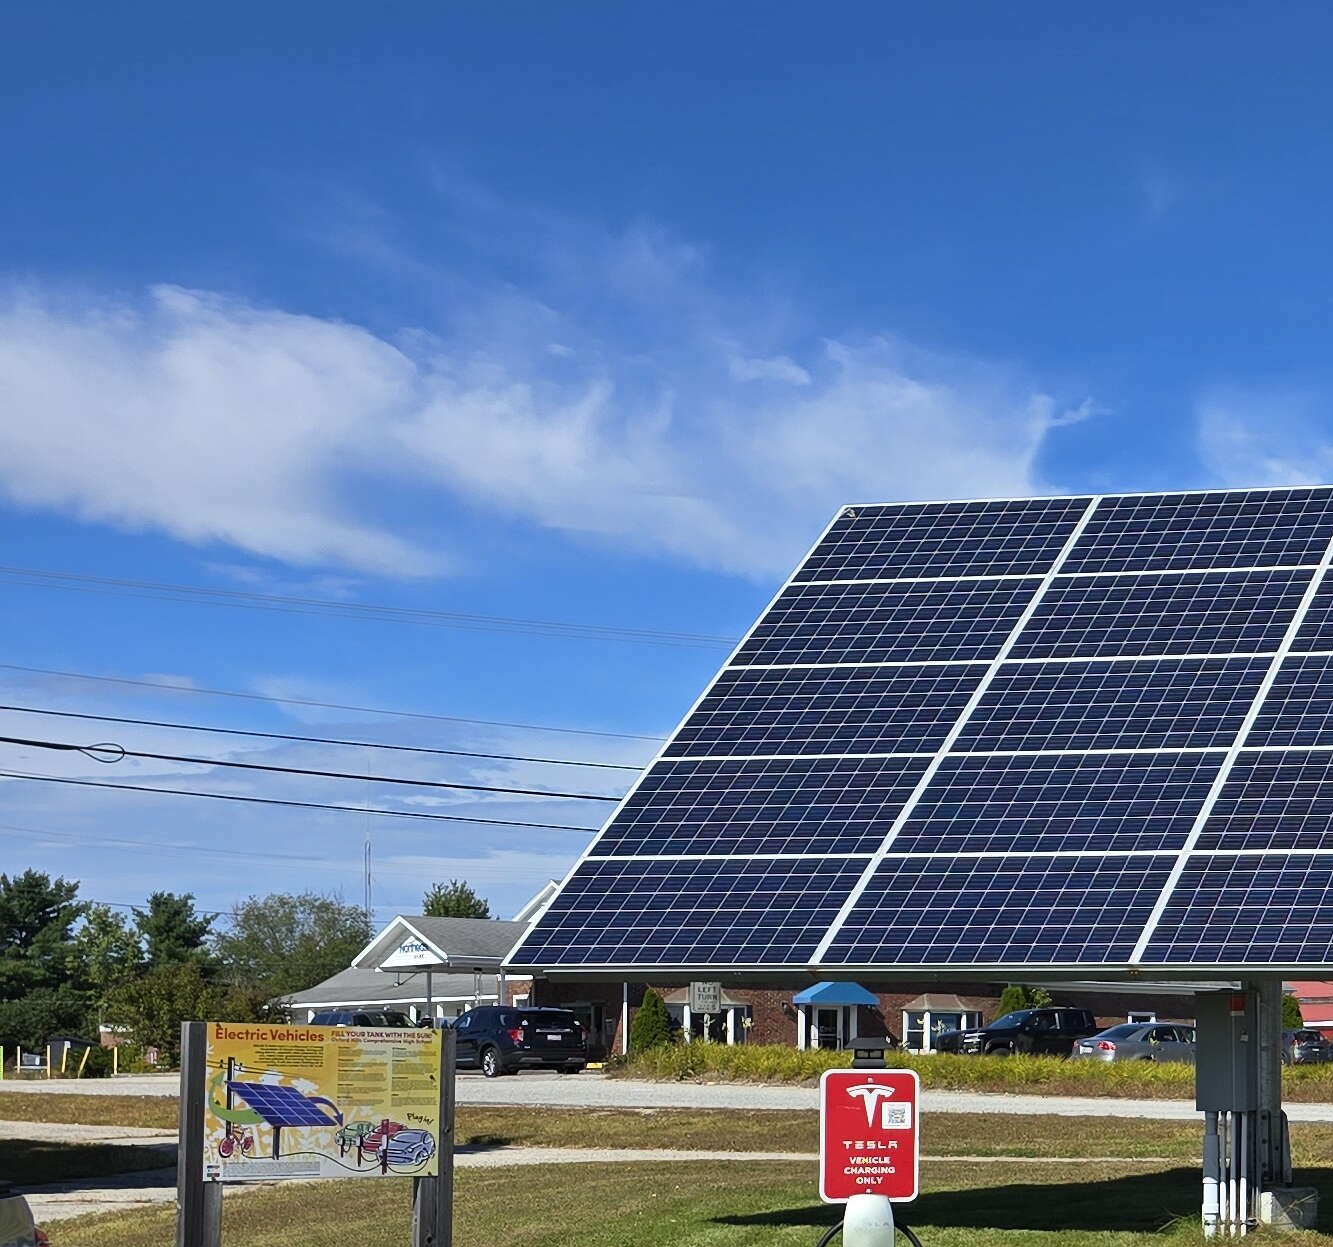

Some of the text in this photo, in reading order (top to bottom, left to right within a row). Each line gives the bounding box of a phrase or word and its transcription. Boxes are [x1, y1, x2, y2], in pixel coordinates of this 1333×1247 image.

[216, 1028, 325, 1041] Electric Vehicles
[843, 1141, 898, 1149] TESLA
